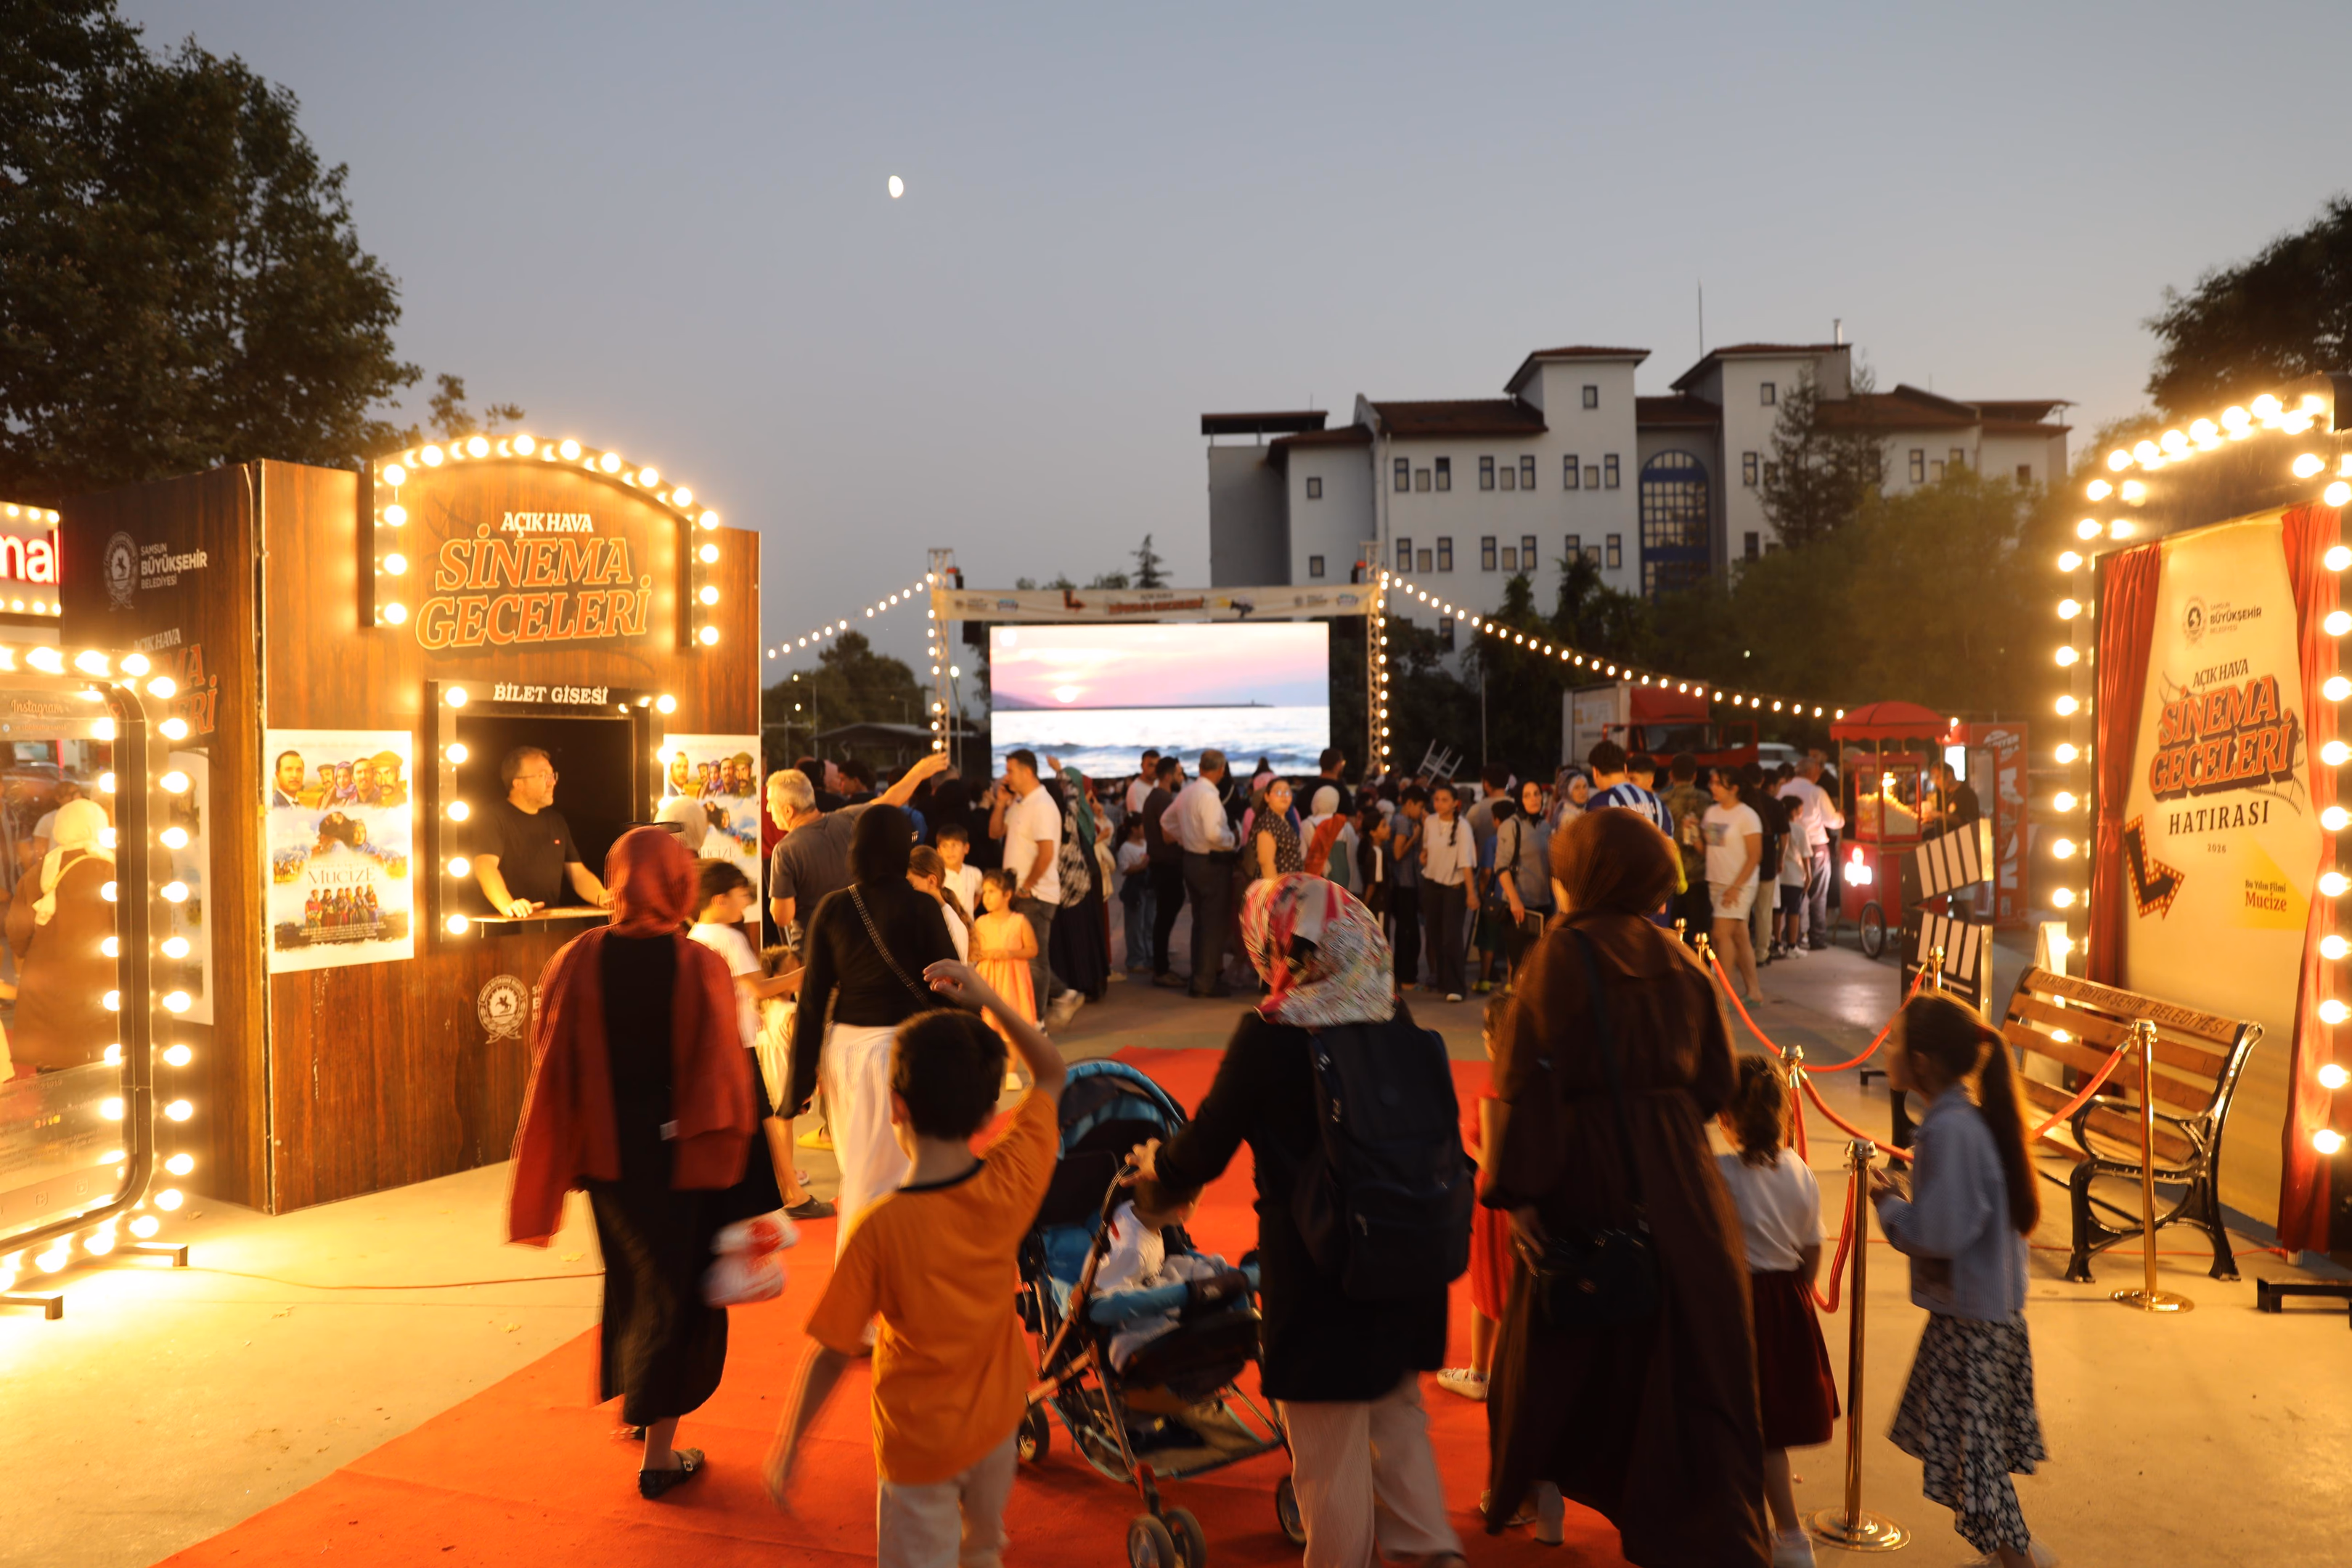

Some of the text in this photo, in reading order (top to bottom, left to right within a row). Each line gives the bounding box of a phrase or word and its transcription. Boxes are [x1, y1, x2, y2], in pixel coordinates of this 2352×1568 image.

[500, 512, 594, 538] AÇIK HAVA
[141, 542, 167, 556] SAMSUN
[141, 548, 208, 576] BÜYÜKŞEHİR
[435, 523, 634, 591] SİNEMA
[415, 574, 652, 650] GECELERİ
[2210, 605, 2262, 625] BÜYÜKŞEHİR
[155, 628, 181, 649] HAVA
[2192, 658, 2249, 693] AÇIK HAVA
[493, 683, 608, 705] BİLET GİŞESİ
[11, 699, 63, 718] Instagram
[2158, 675, 2278, 746] SİNEMA
[2149, 709, 2295, 795] GECELERİ
[2168, 800, 2269, 836] HATIRASI
[2245, 891, 2287, 912] Mucize
[2037, 975, 2074, 992] SAMSUN
